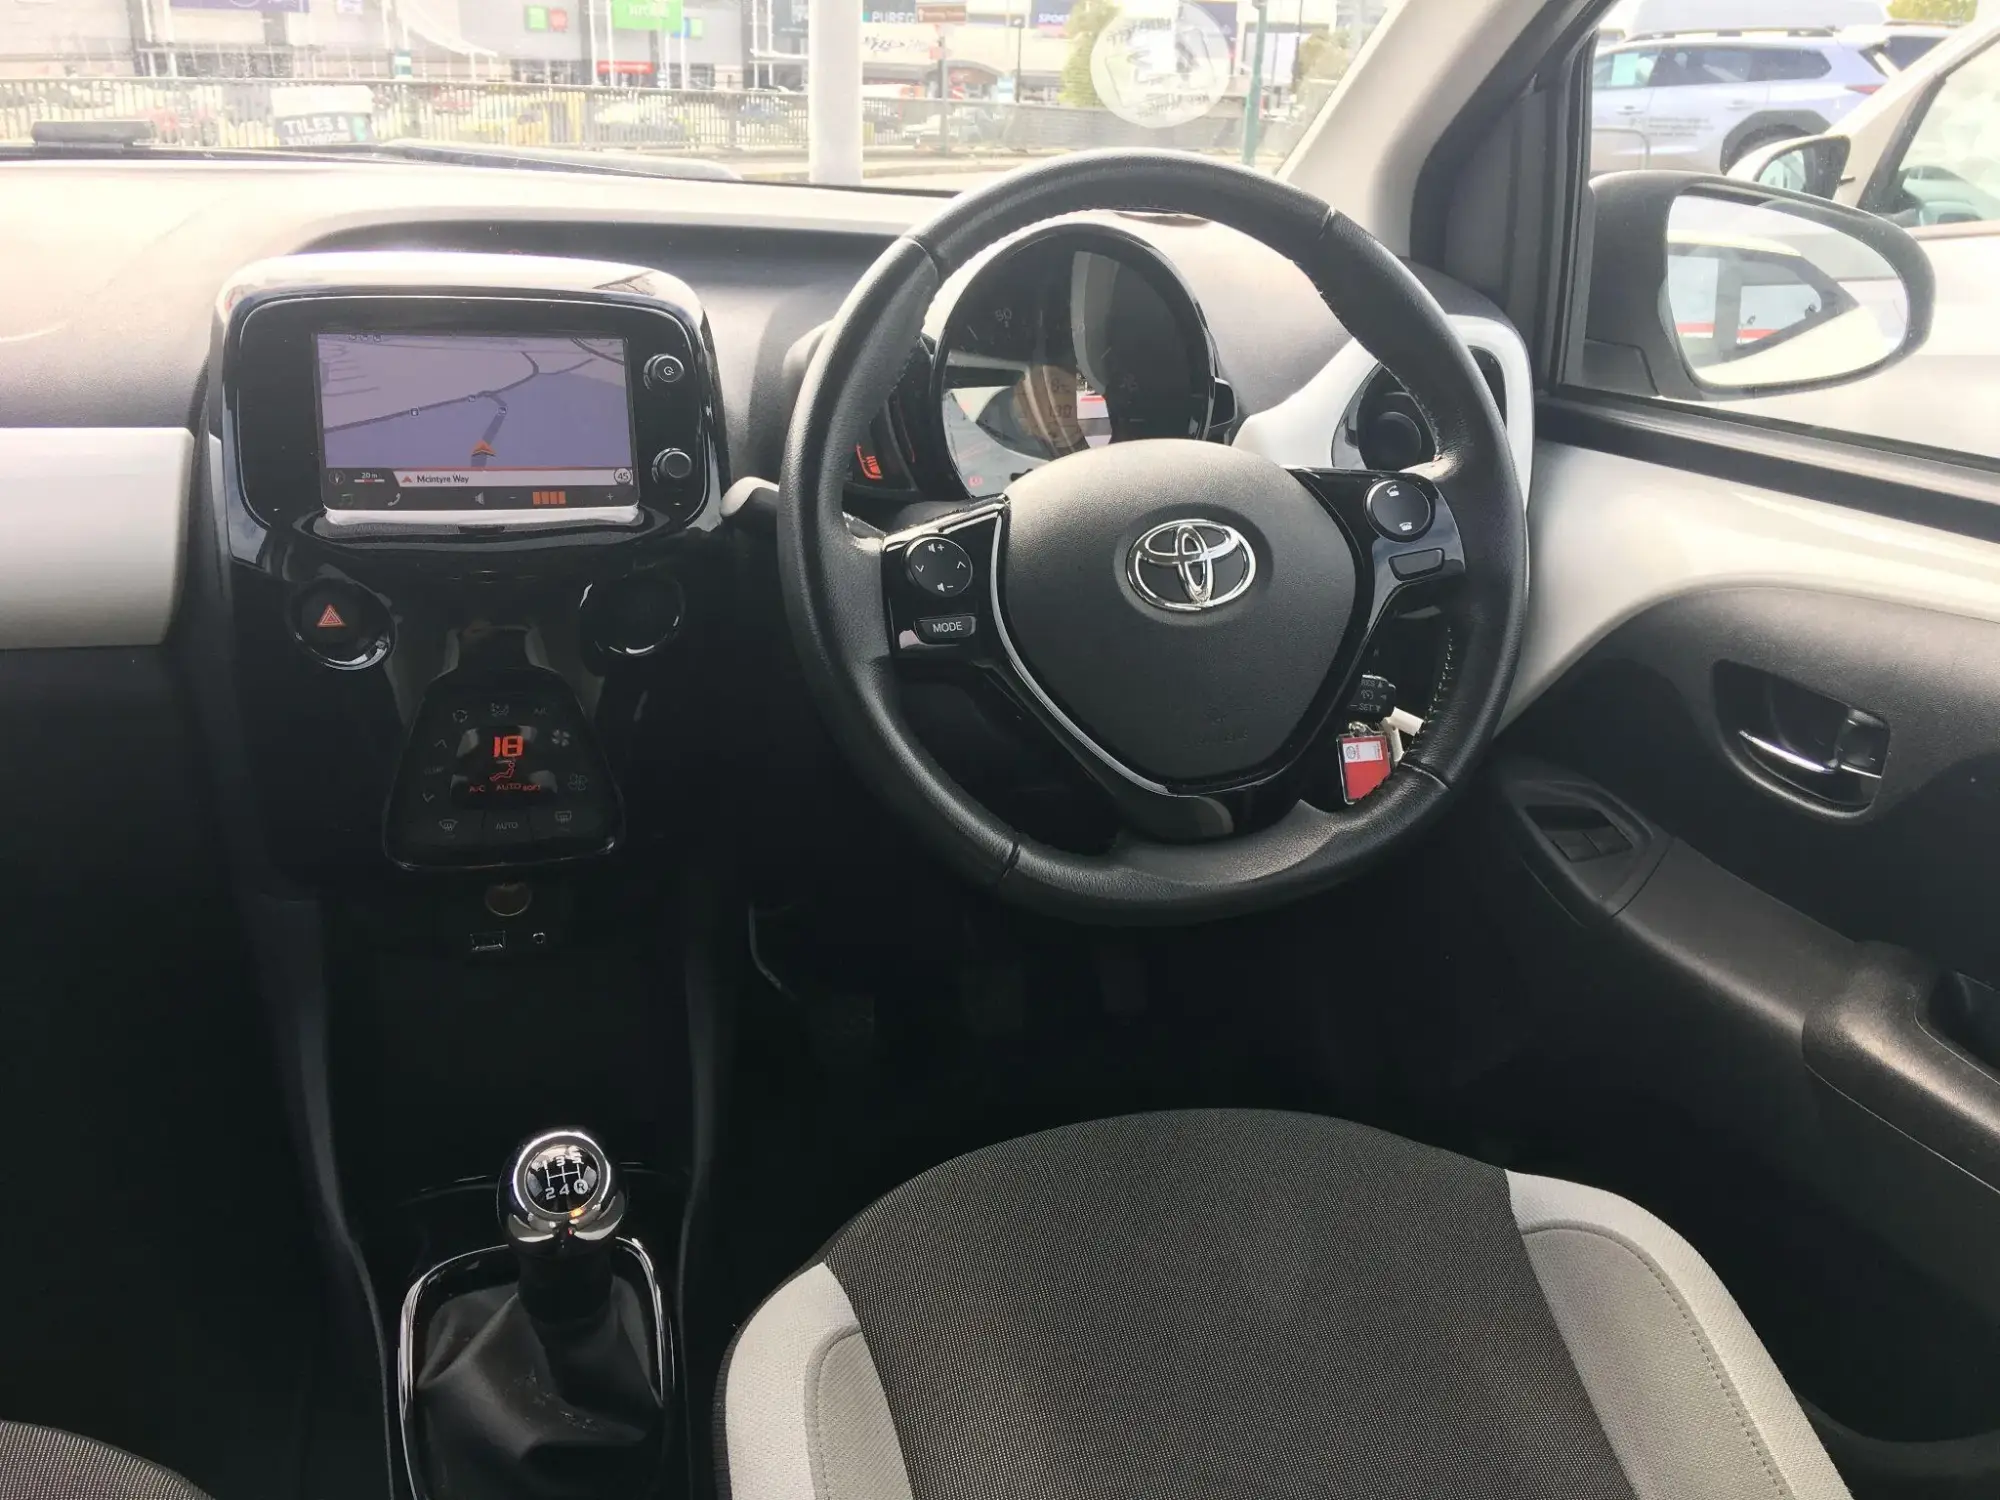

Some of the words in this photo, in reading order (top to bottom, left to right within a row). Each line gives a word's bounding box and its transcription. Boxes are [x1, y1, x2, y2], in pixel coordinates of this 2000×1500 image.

[283, 117, 334, 135] TILES
[452, 473, 469, 484] Way
[617, 472, 629, 480] 45
[932, 621, 963, 633] MODE
[493, 736, 523, 758] 18
[496, 821, 518, 831] AUTO
[556, 1156, 566, 1167] 3
[545, 1187, 556, 1200] 2
[559, 1183, 570, 1195] 4
